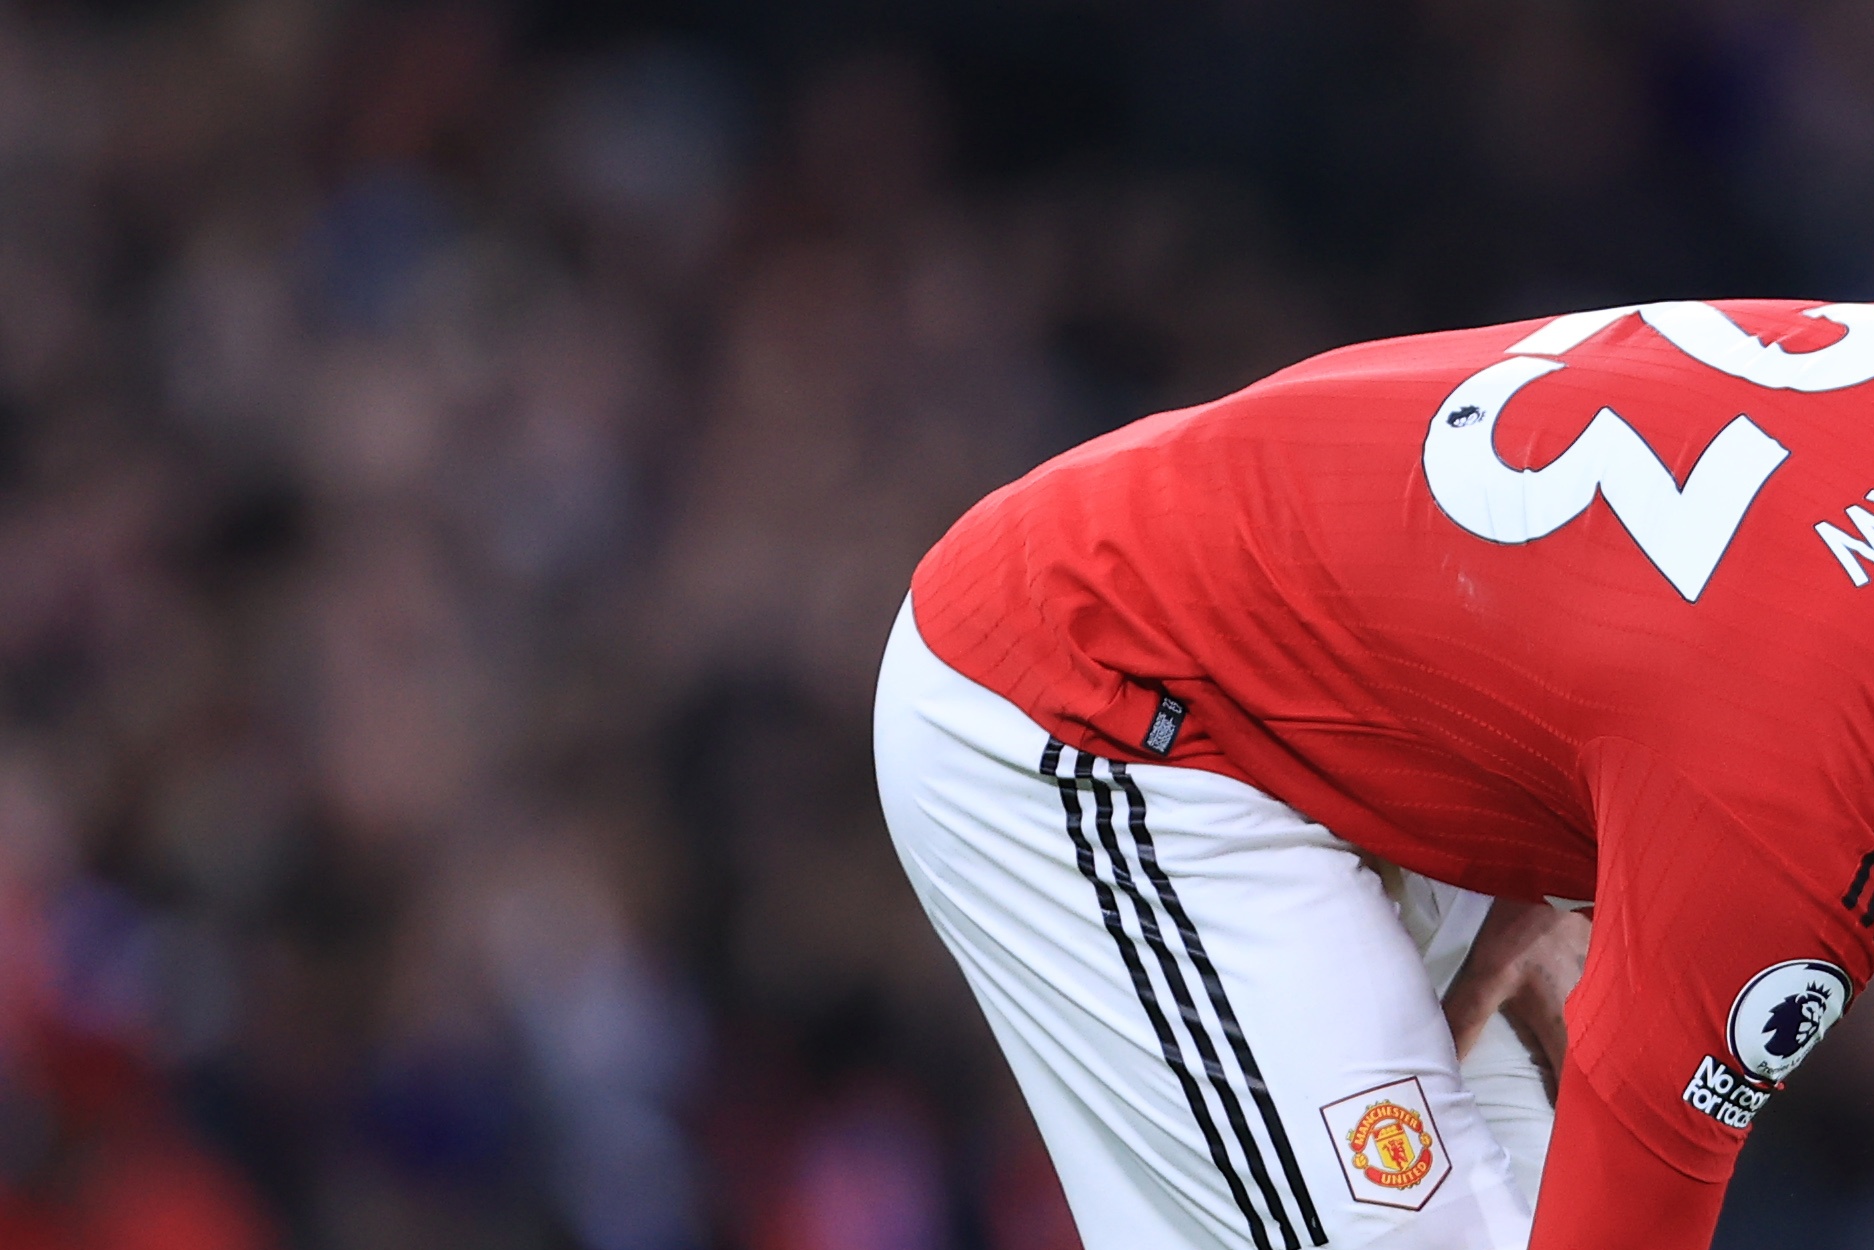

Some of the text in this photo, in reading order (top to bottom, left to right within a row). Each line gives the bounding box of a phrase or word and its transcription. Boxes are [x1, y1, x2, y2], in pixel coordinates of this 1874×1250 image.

[1694, 1055, 1734, 1094] No
[1682, 1078, 1723, 1115] For
[1354, 1106, 1418, 1145] MANCHESTER
[1380, 1160, 1428, 1185] UNITED
